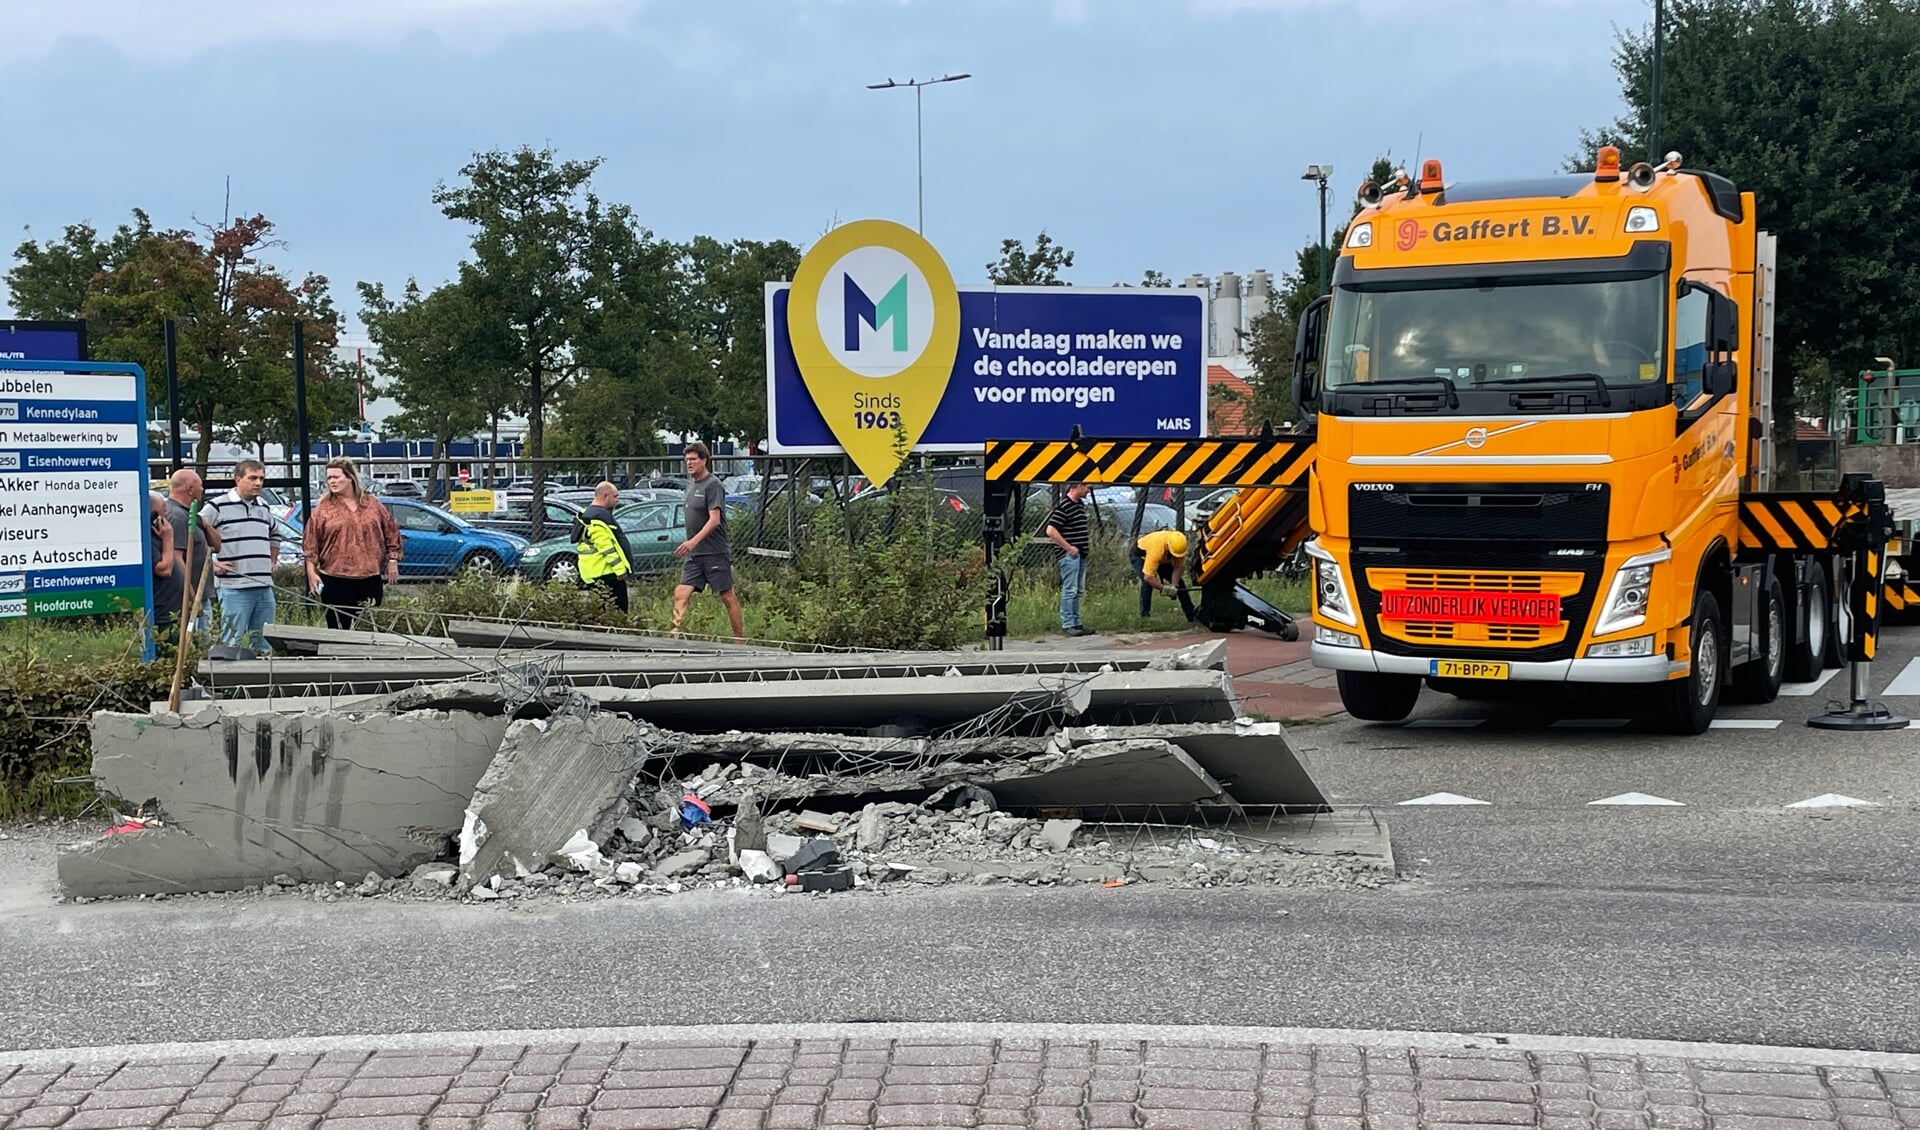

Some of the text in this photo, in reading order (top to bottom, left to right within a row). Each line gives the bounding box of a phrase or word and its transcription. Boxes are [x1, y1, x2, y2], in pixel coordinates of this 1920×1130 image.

[1433, 218, 1530, 242] Gaffert
[1542, 215, 1595, 236] B.V.
[844, 272, 908, 352] M
[972, 327, 1183, 355] Vandaag maken we
[973, 354, 1177, 381] de chocoladerepen
[854, 392, 901, 409] Sinds
[973, 386, 1116, 408] voor morgen
[26, 406, 98, 421] Kennedylaan
[854, 411, 901, 430] 1963
[1156, 417, 1191, 430] MARS
[13, 431, 103, 444] Metaalbewerking
[106, 431, 118, 442] bv
[28, 455, 112, 468] Eisenhowerweg
[0, 477, 119, 492] Akker Honda Dealer
[1353, 483, 1394, 491] VOLVO
[1585, 483, 1602, 491] FH
[0, 502, 124, 518] kel Aanhangwagens
[0, 547, 118, 566] ans Autoschade
[33, 575, 116, 588] Eisenhowerweg
[34, 599, 94, 613] Hoofdroute
[1385, 594, 1558, 619] UITZONDERLIJK VERVOER
[1445, 663, 1501, 676] 71-BPP-7
